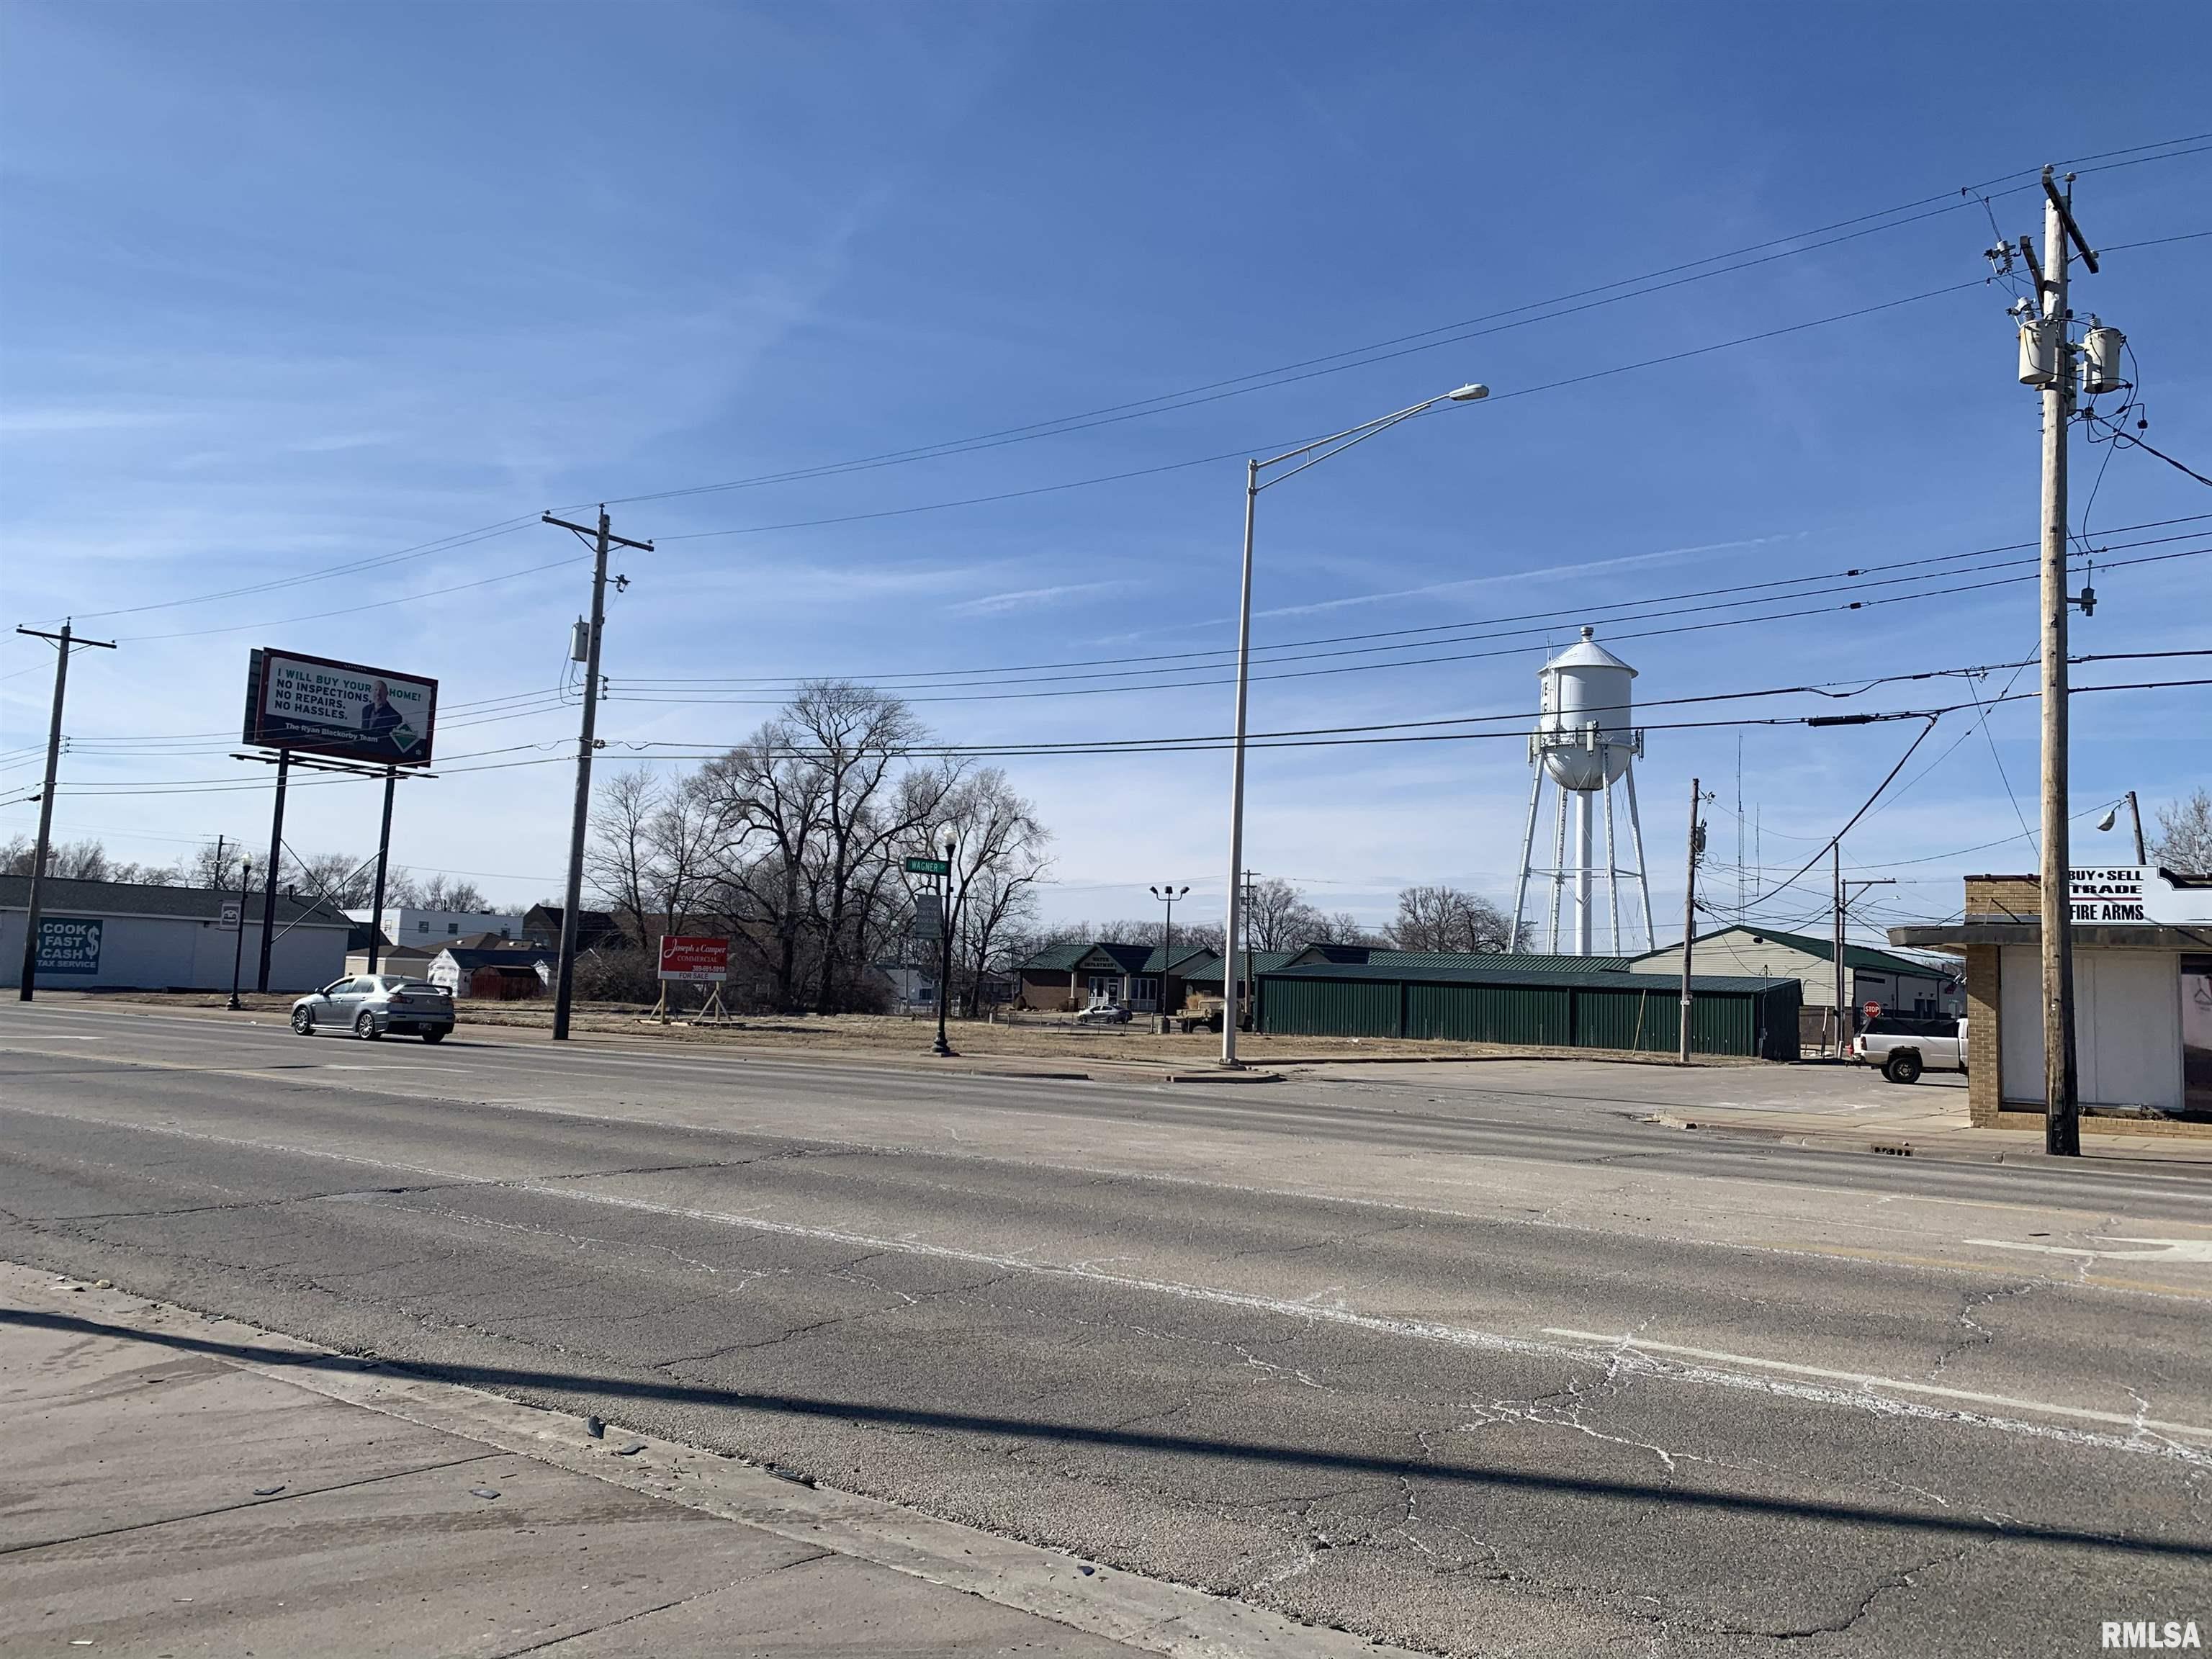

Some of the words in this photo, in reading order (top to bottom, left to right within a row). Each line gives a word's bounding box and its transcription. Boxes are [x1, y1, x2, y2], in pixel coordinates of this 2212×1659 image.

[276, 678, 292, 689] NO
[297, 683, 372, 703] INSPECTIONS.
[286, 669, 311, 682] WILL
[316, 675, 339, 686] BUY
[343, 680, 372, 693] YOUR
[389, 689, 421, 702] HOME!
[276, 689, 292, 699] NO
[296, 693, 346, 709] REPAIRS.
[274, 700, 290, 710] NO
[295, 703, 348, 720] HASSLES.
[301, 725, 320, 734] Ryan
[321, 728, 359, 740] Blackorby
[359, 734, 378, 743] Team
[912, 860, 938, 872] WAGNER
[2069, 871, 2096, 881] BUY
[2107, 871, 2144, 881] SELL
[2069, 885, 2143, 894] TRADE
[2069, 904, 2098, 920] FIRE
[2102, 904, 2144, 920] ARMS
[43, 923, 86, 935] COOK
[45, 936, 84, 947] FAST
[663, 938, 694, 958] Joseph
[701, 944, 727, 956] Camper
[41, 948, 84, 959] CASH
